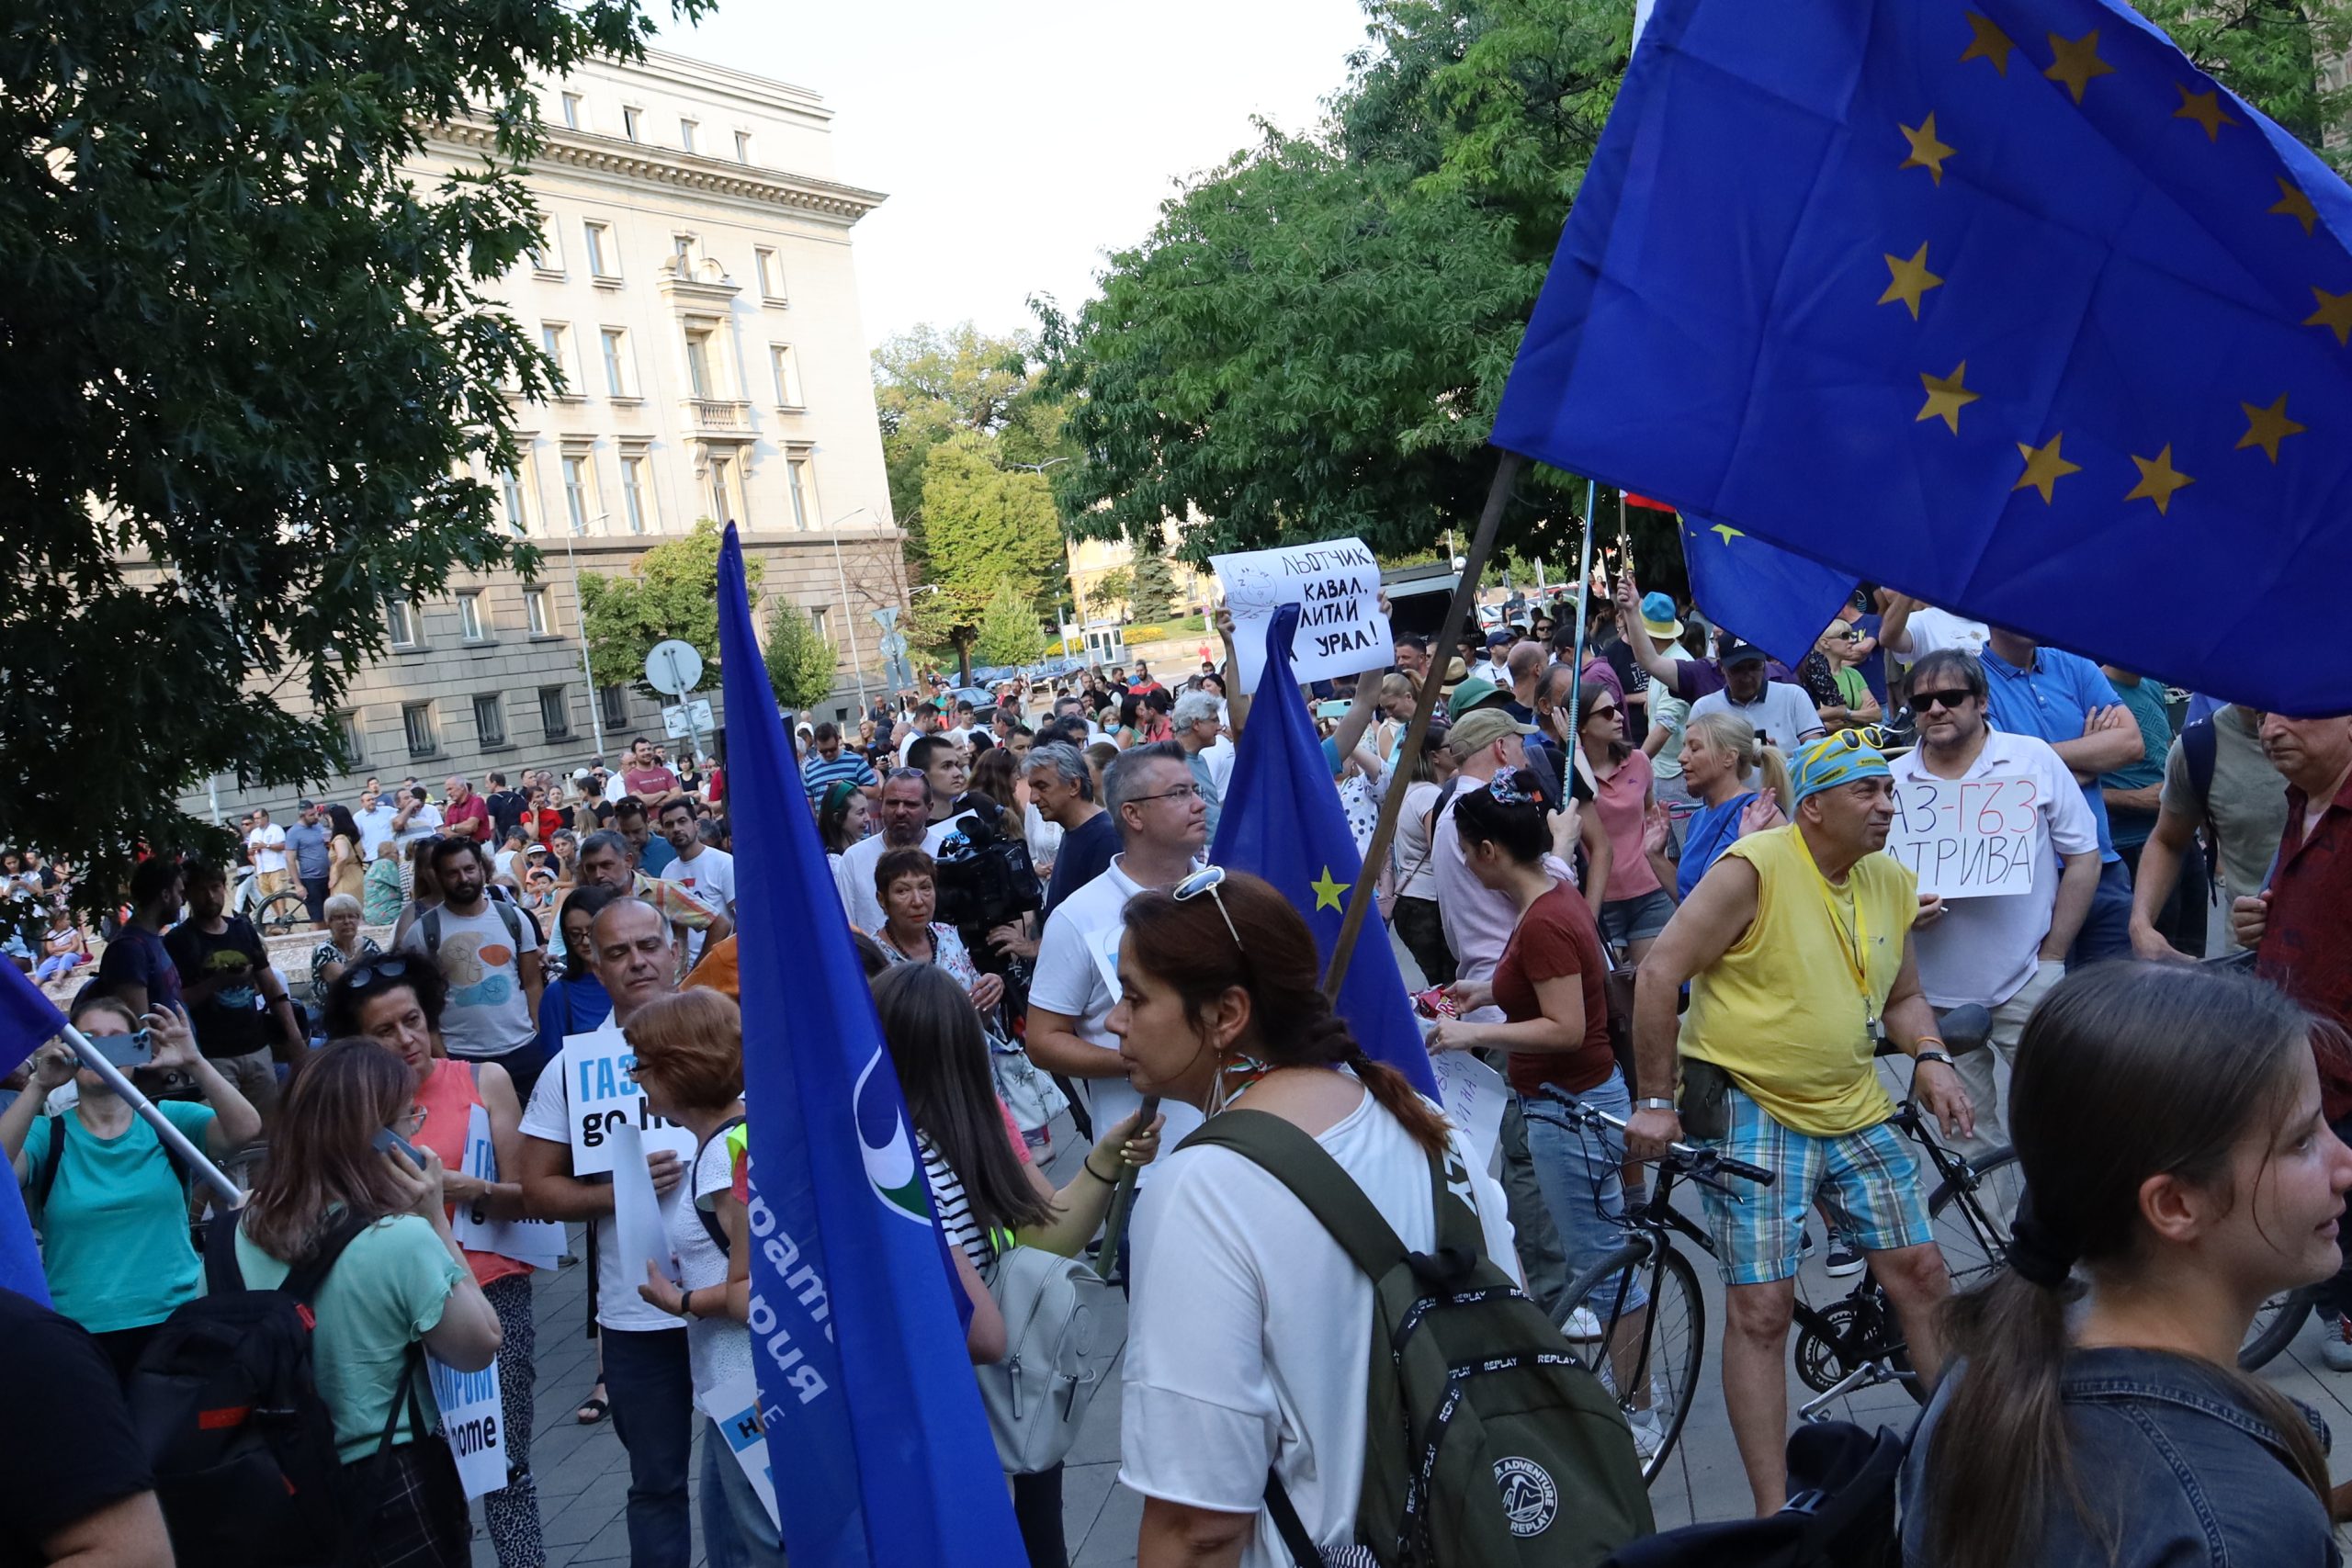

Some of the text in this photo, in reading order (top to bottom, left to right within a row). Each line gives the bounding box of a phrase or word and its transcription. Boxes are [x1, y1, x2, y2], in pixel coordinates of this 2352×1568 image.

[1282, 547, 1375, 576] ЛЬОТЧИК,
[1304, 576, 1368, 603] КАВАЛ,
[1315, 620, 1379, 657] УРАЛ!
[1892, 780, 2038, 835] АЗ-ГЪЗ
[579, 1054, 639, 1103] ГАЗ
[582, 1109, 628, 1147] go
[747, 1270, 829, 1405] рия
[1483, 1357, 1518, 1371] REPLAY
[1537, 1354, 1577, 1366] REPLAY
[1504, 1460, 1555, 1507] ADVENTURE
[1510, 1509, 1550, 1534] REPLAY
